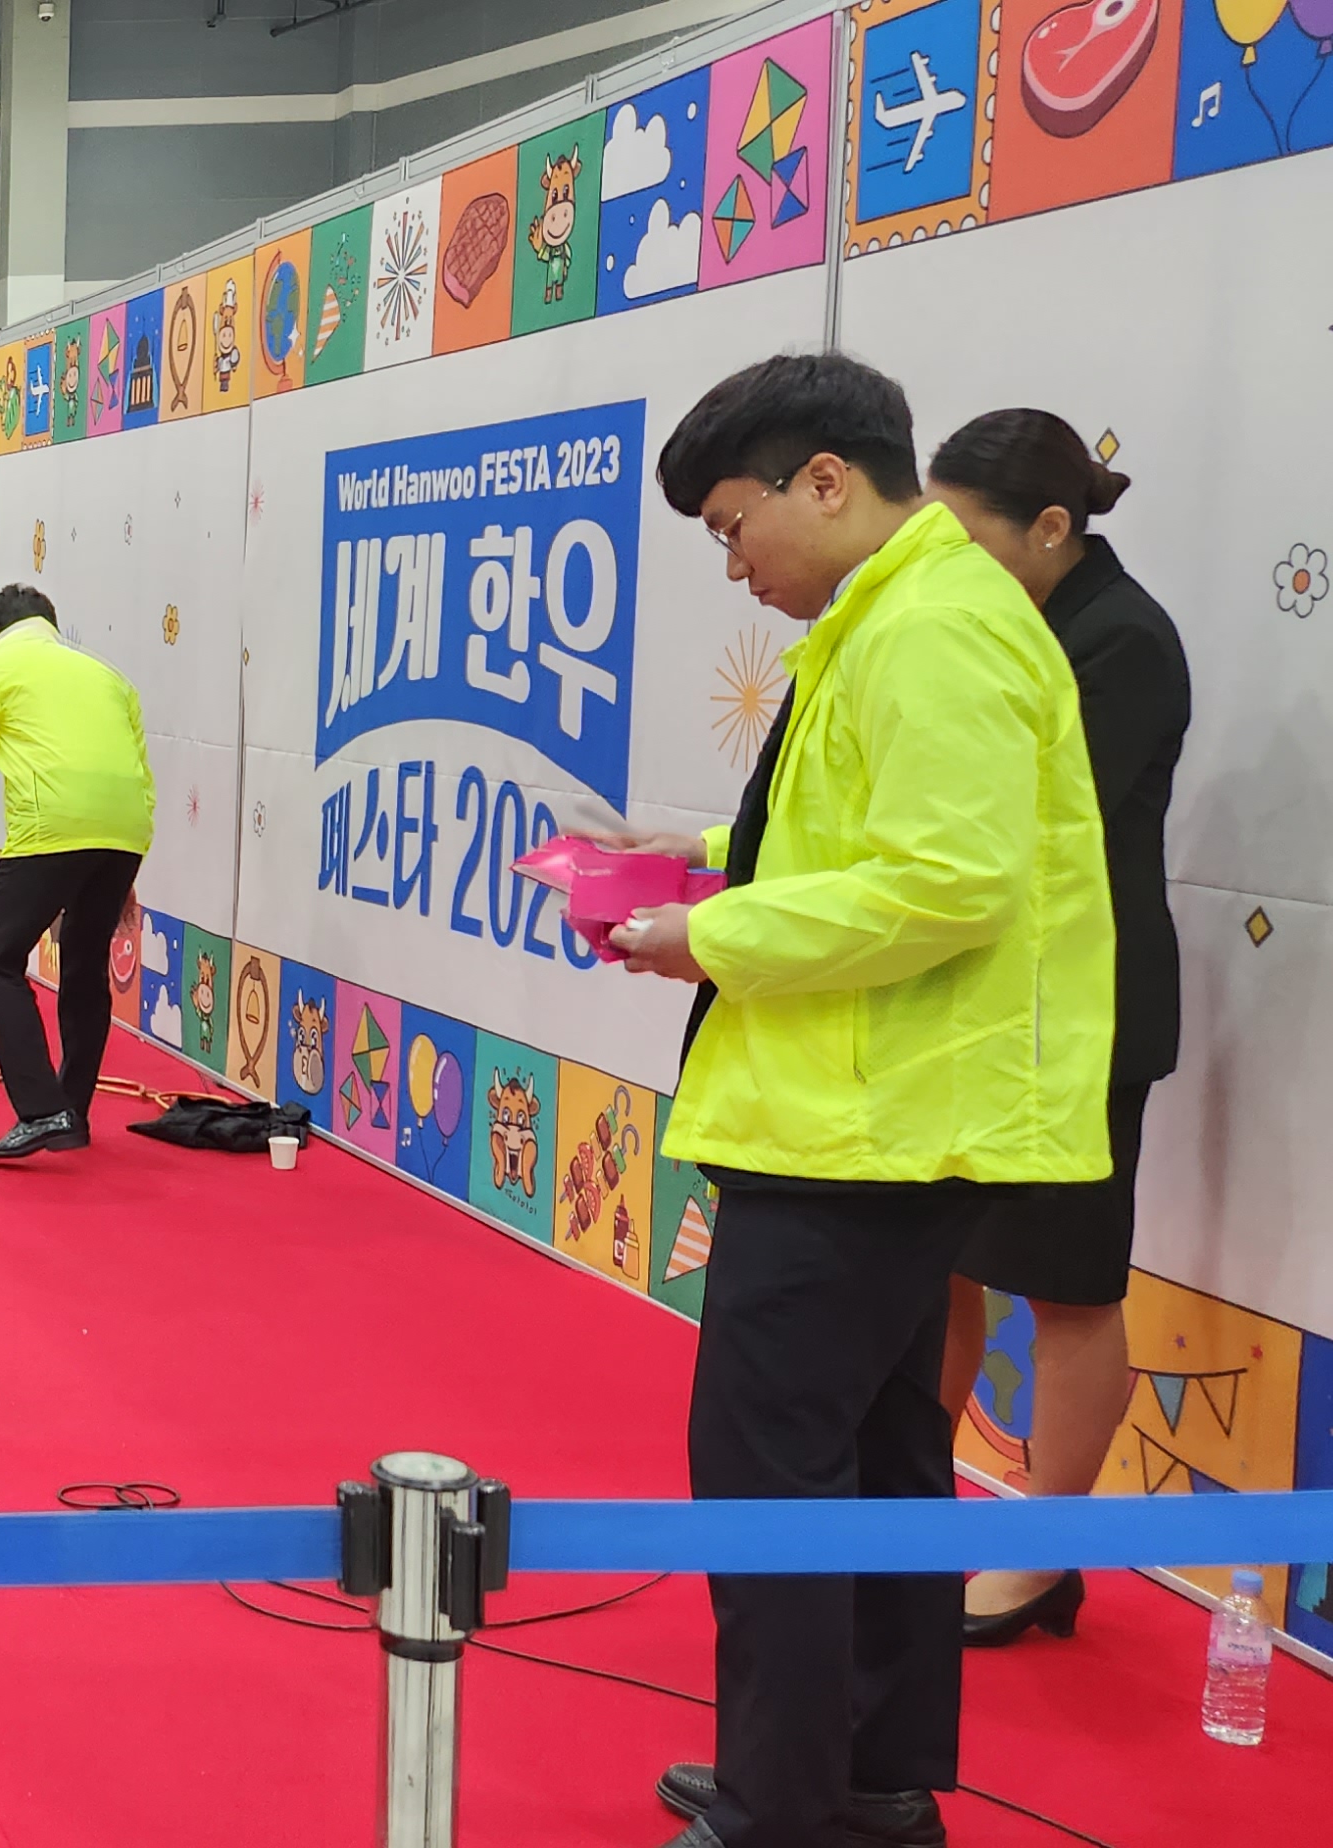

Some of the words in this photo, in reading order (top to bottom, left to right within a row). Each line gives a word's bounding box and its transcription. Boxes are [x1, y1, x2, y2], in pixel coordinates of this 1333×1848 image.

[338, 467, 391, 512] World
[392, 464, 476, 507] Hanwoo
[479, 445, 551, 498] FESTA
[555, 434, 621, 490] 2023
[325, 532, 446, 729] 세계
[465, 518, 618, 742] 한우
[317, 760, 439, 917] 페스타
[450, 764, 601, 971] 202
